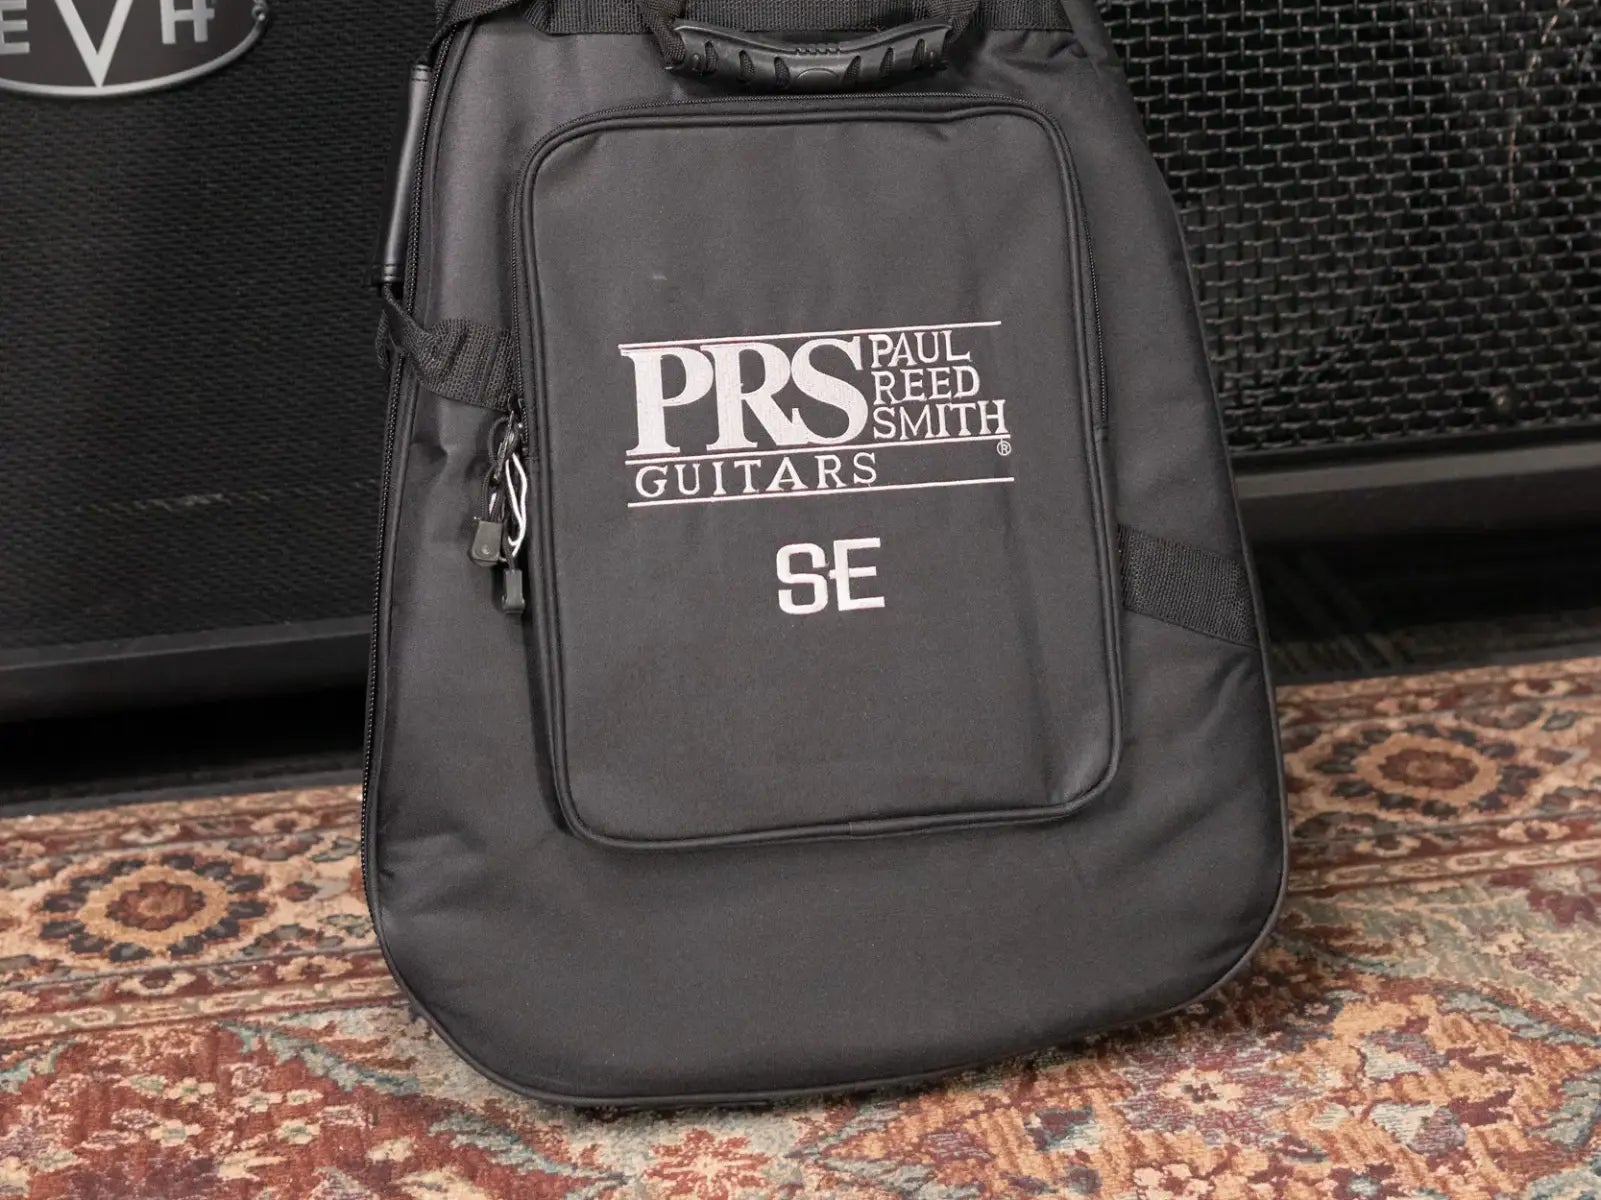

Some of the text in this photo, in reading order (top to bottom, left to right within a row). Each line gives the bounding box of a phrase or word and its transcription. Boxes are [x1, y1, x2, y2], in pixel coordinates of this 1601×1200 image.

[869, 329, 971, 368] PAUL
[620, 335, 869, 457] PRS
[872, 365, 981, 406] REED
[873, 399, 1011, 441] SMITH
[635, 451, 878, 498] GUITARS
[775, 536, 886, 615] SE
